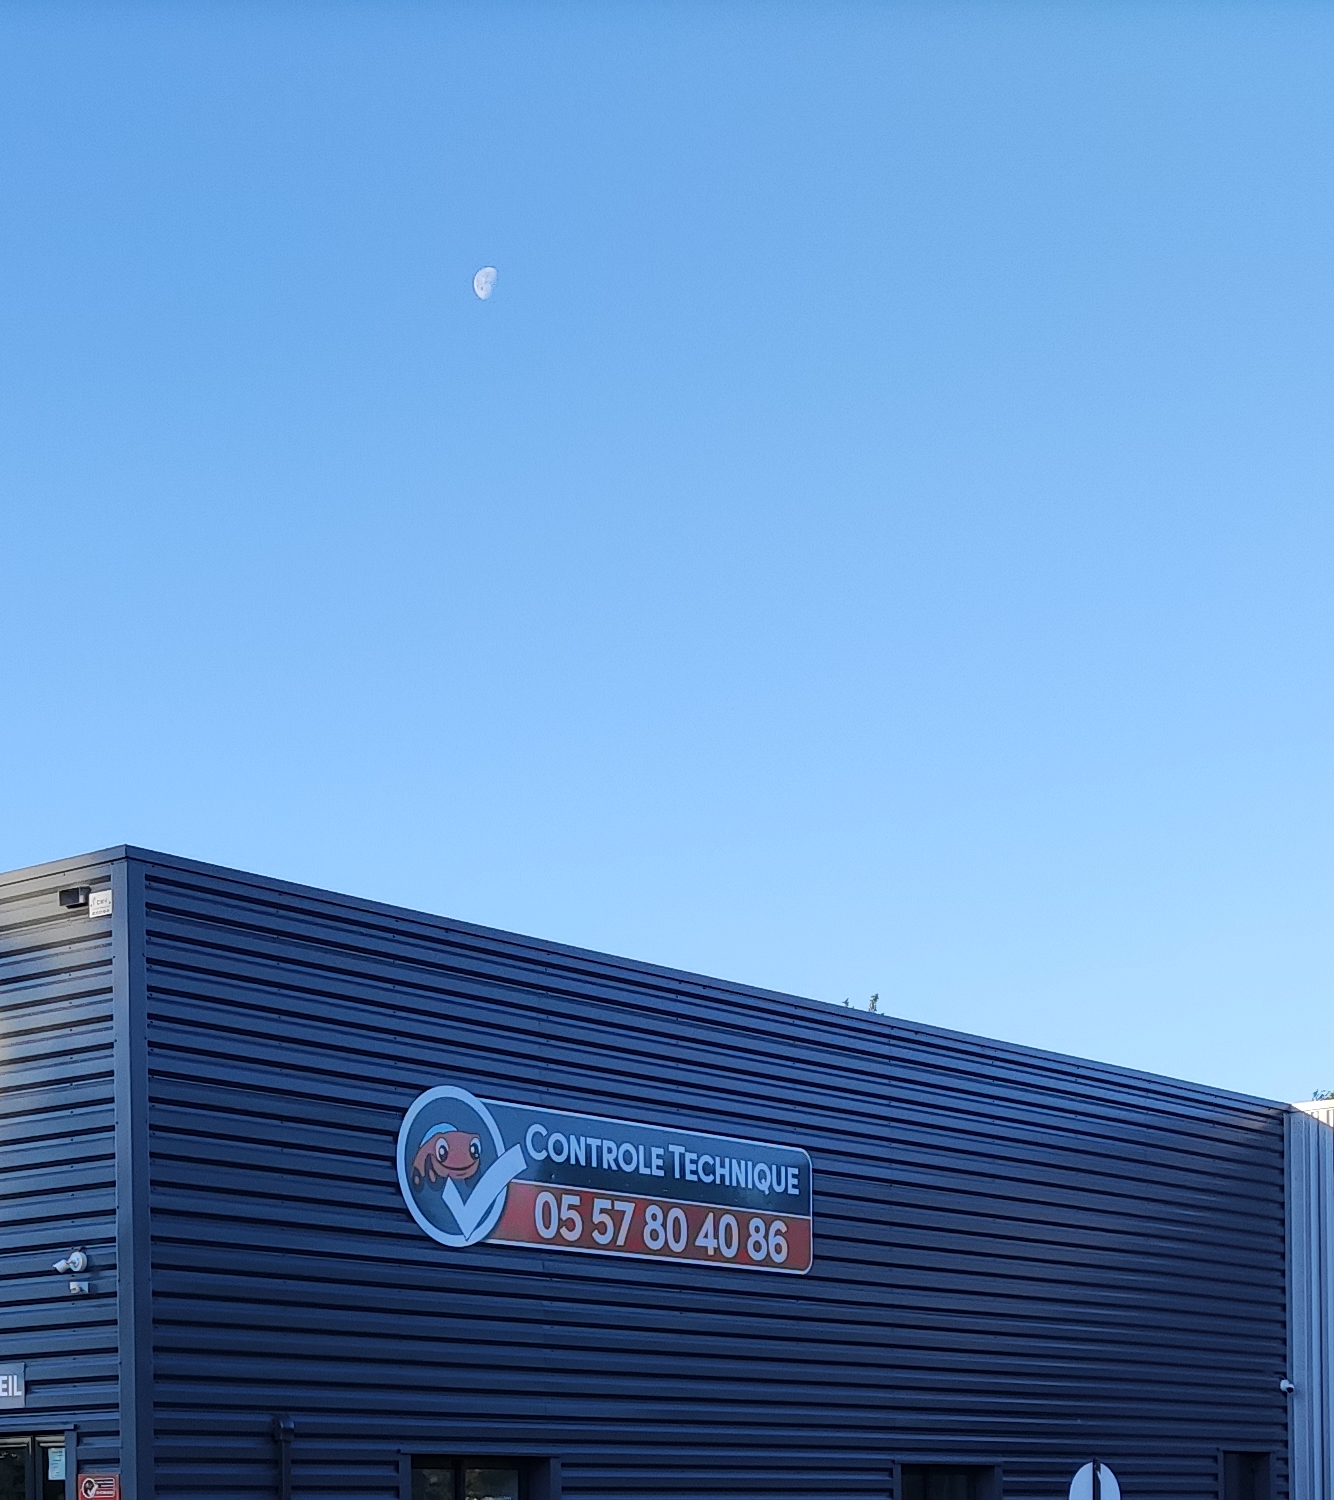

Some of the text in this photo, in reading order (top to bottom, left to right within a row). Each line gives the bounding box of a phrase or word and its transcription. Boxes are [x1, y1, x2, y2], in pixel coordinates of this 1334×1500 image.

[525, 1123, 800, 1195] CONTROLE TECHNIQUE
[534, 1191, 789, 1264] 05 57 80 40 86
